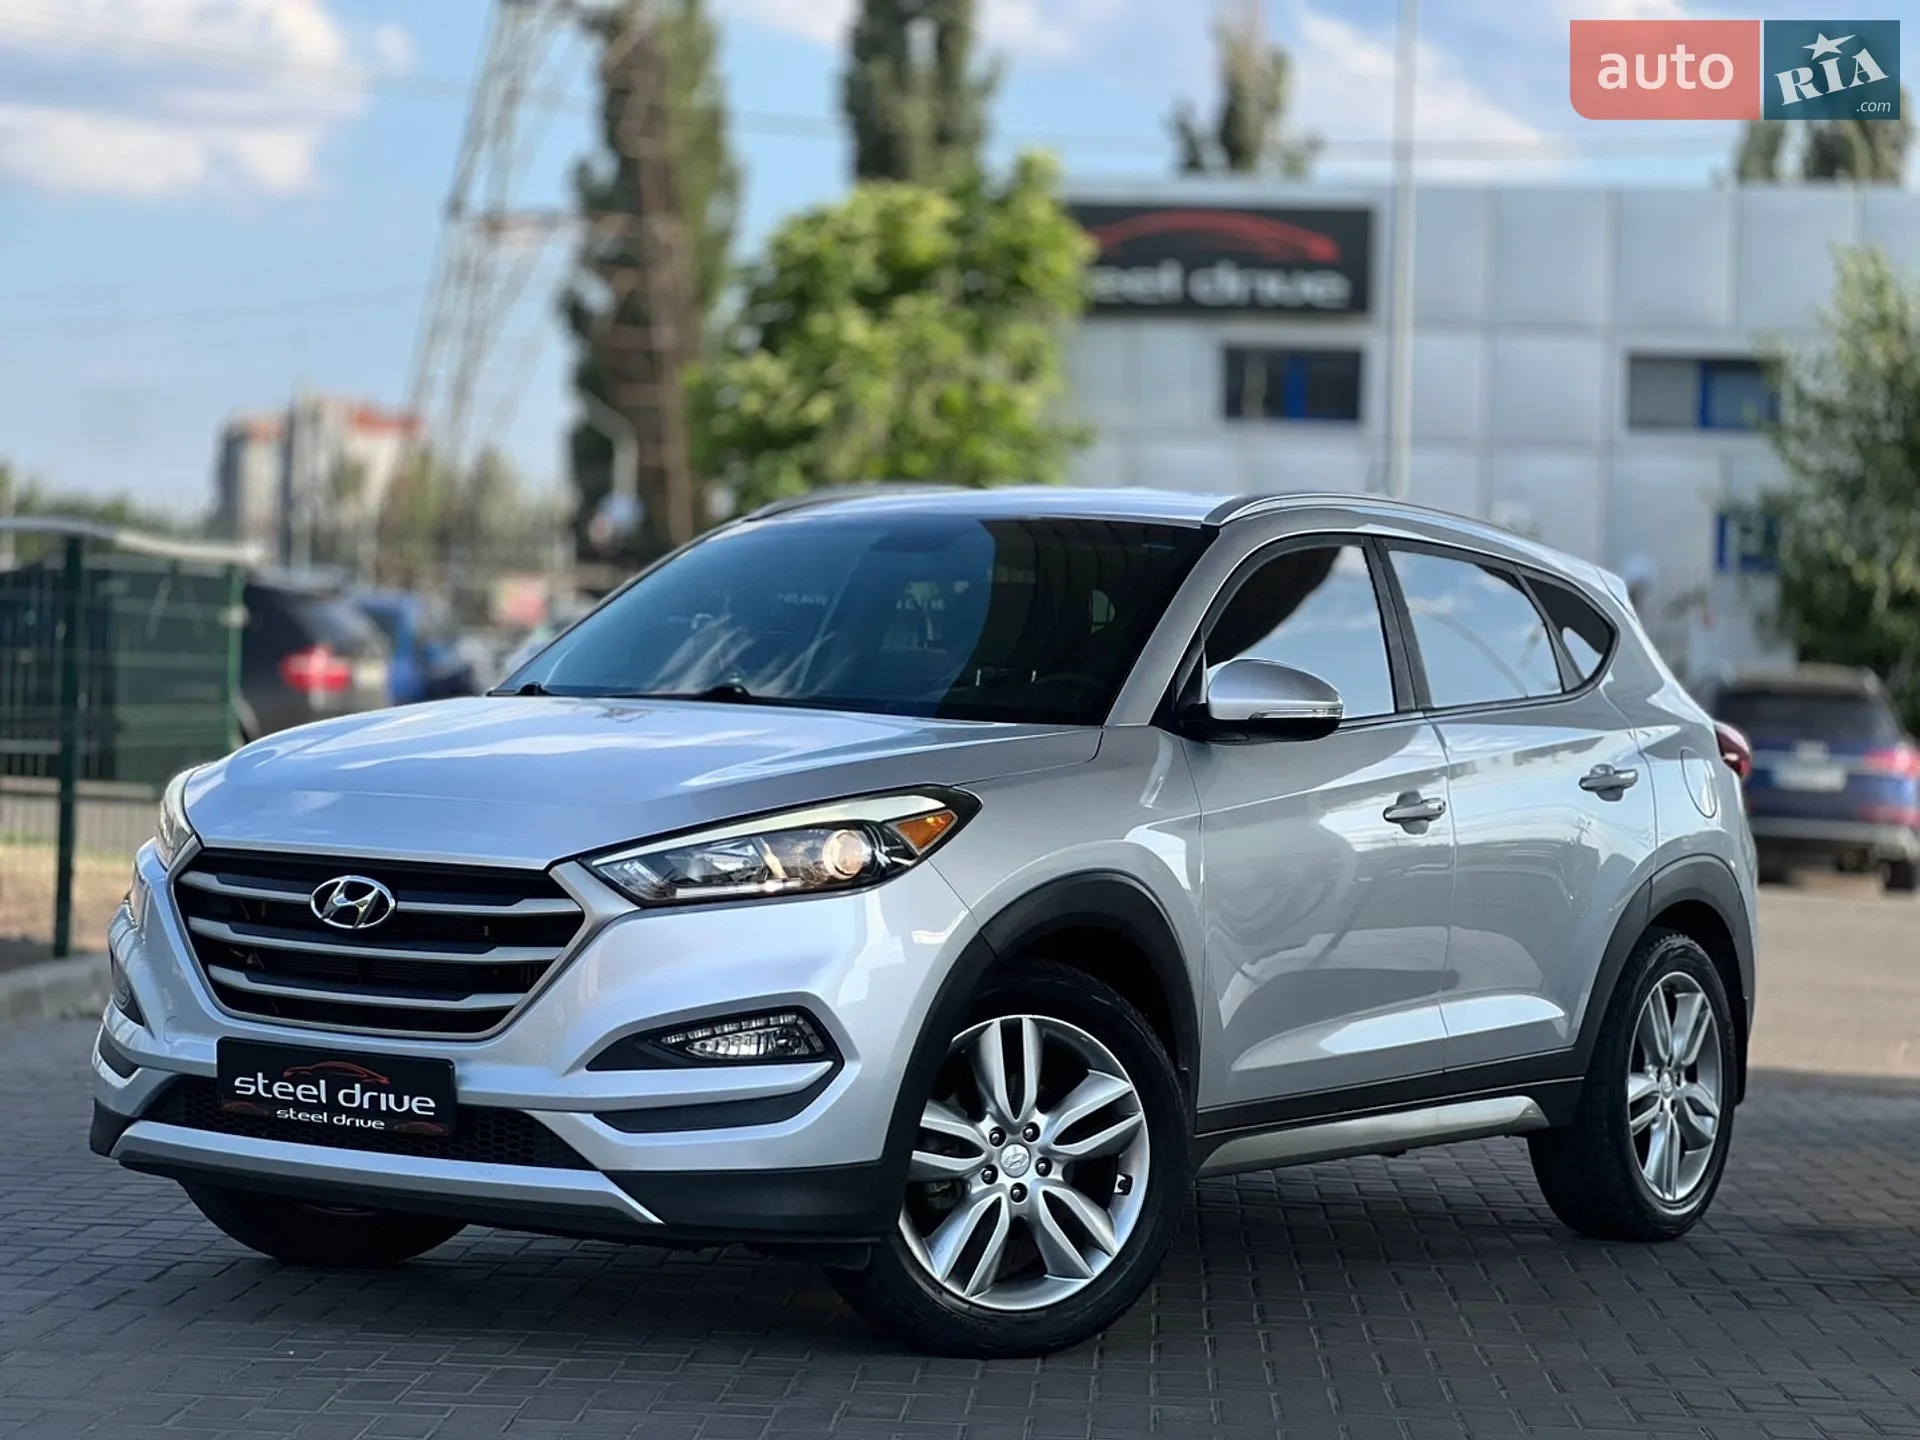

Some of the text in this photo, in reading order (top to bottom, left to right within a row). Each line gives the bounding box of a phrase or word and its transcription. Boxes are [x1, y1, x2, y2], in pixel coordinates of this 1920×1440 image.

[1086, 257, 1184, 306] eel
[234, 1072, 436, 1116] steel drive
[276, 1107, 386, 1130] steel drive
